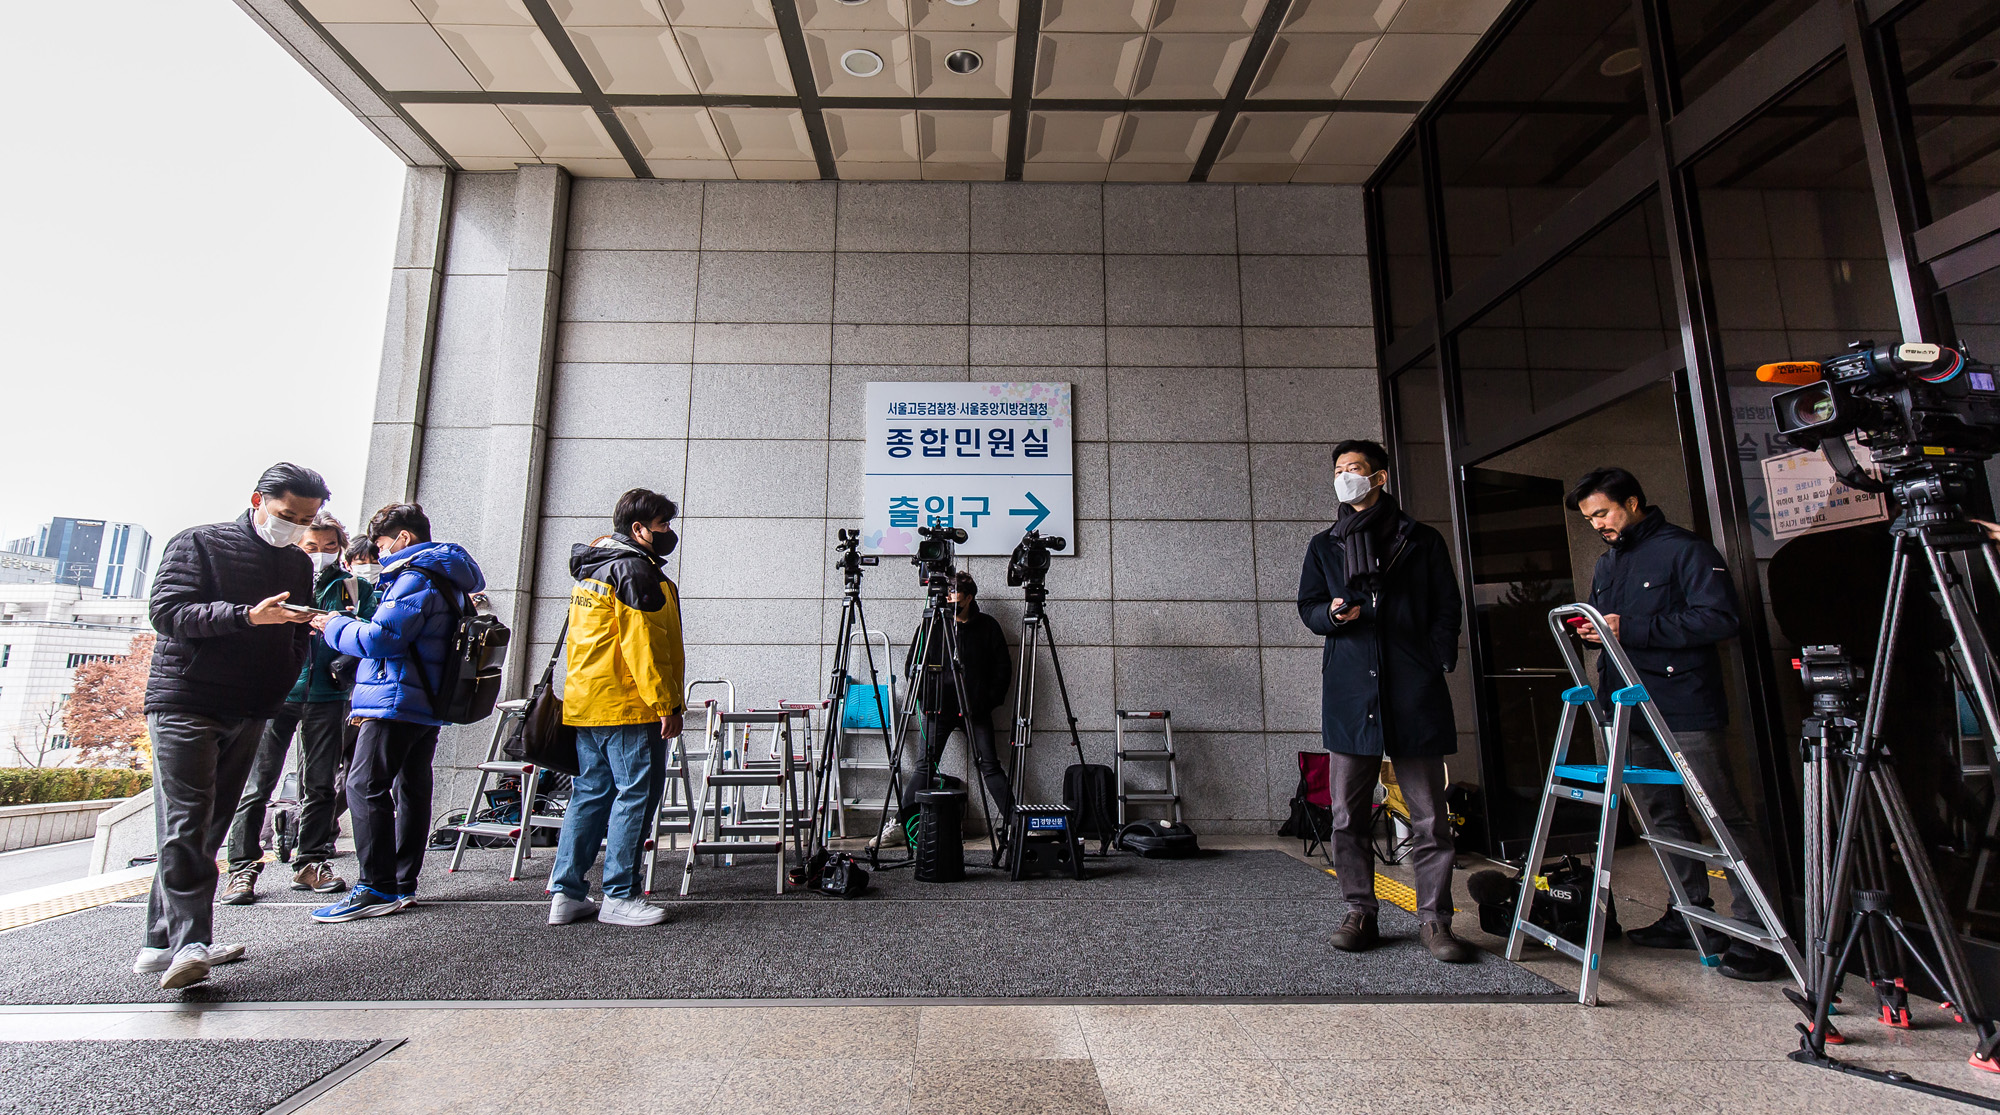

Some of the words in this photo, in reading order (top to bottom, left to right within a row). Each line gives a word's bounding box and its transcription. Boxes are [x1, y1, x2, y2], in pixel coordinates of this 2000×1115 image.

[1777, 364, 1820, 374] 연합뉴스TV
[887, 402, 1048, 416] 서울고등검찰청·서울중앙지방검찰청
[886, 428, 1049, 459] 종합민원실
[888, 496, 991, 529] 출입구
[1780, 519, 1797, 528] 주시기
[1550, 888, 1571, 900] KBS
